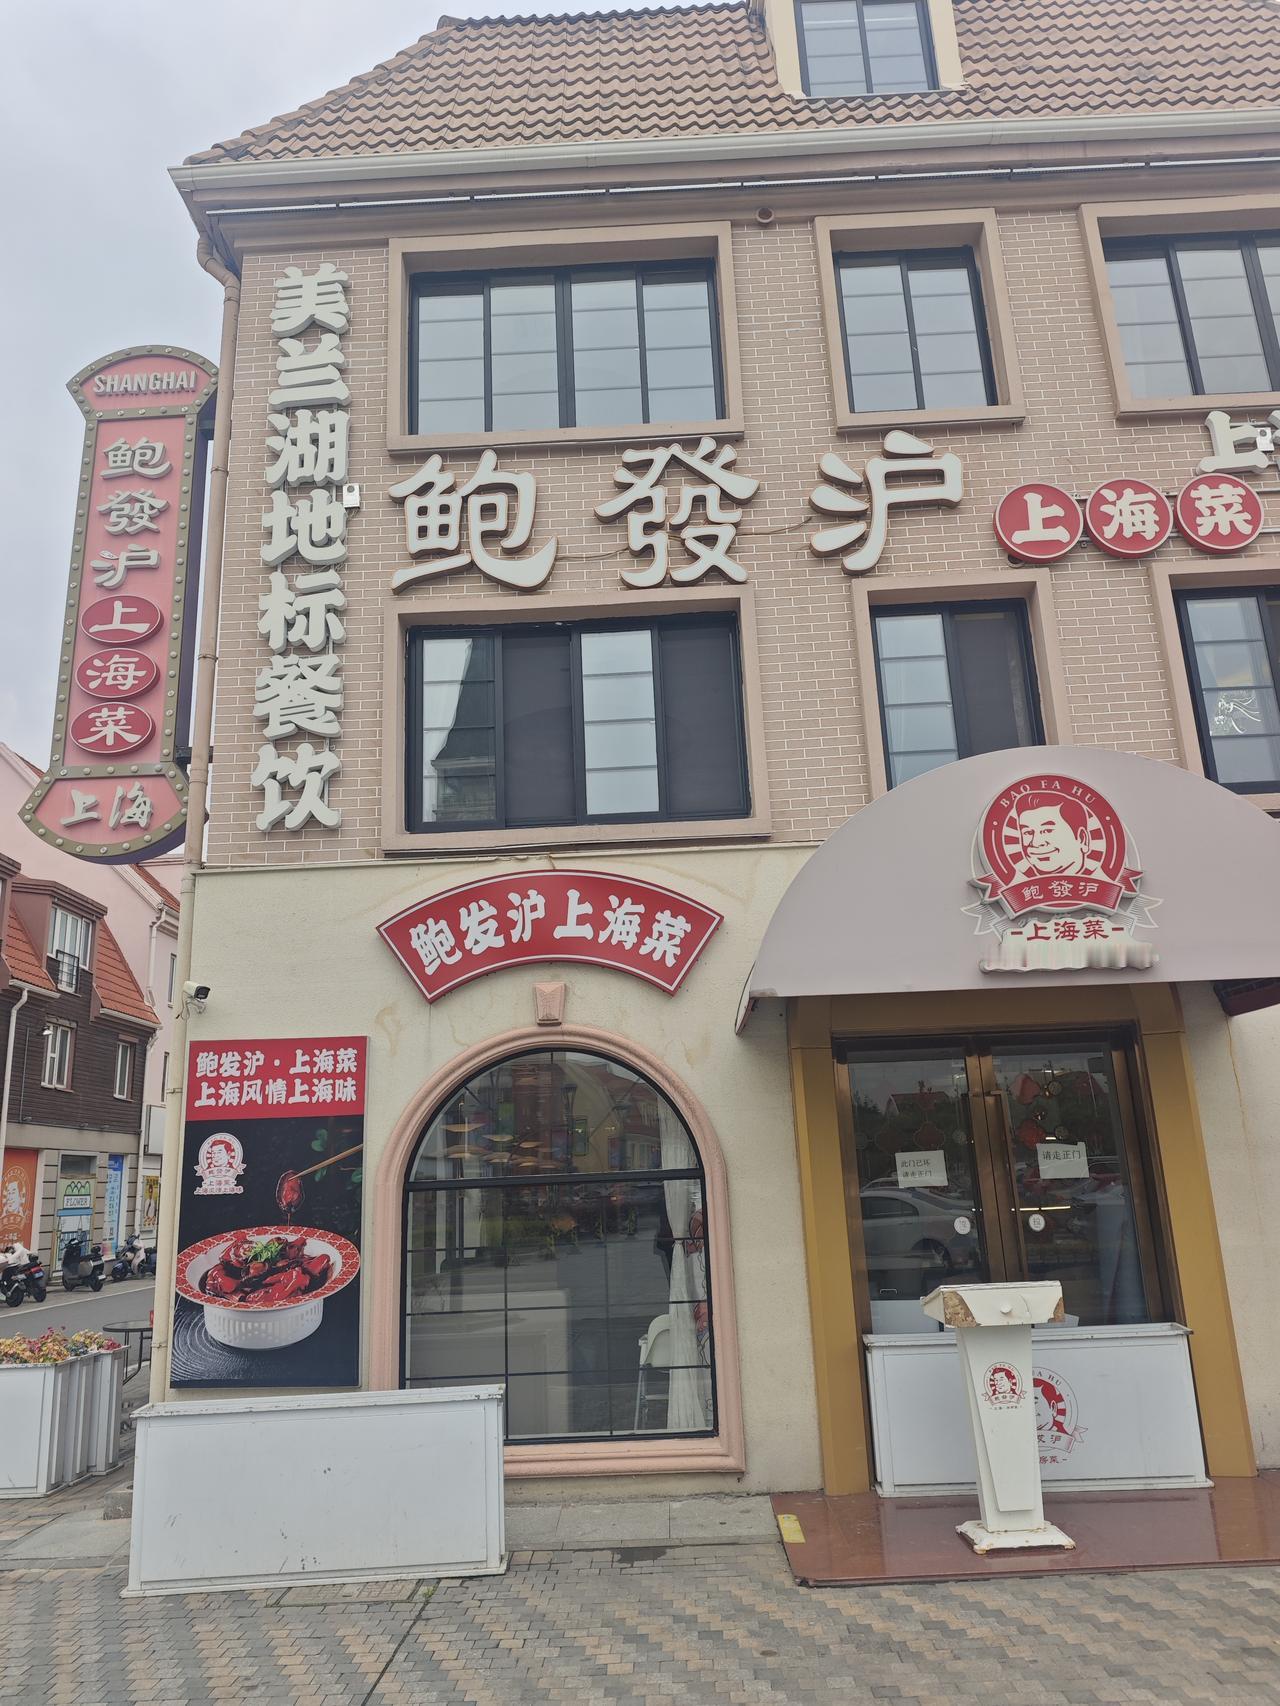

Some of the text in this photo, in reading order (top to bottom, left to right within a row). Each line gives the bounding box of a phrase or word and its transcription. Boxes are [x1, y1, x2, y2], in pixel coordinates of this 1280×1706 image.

[92, 369, 197, 396] SHANGHAI
[1196, 410, 1280, 476] 上
[388, 429, 965, 593] 鲍發沪
[1010, 483, 1254, 541] 上海菜
[251, 262, 352, 832] 美兰湖地标餐饮
[77, 600, 152, 745] 上海菜
[60, 784, 155, 831] 上海
[999, 780, 1097, 809] BAO FA HU
[409, 888, 692, 976] 鲍发沪上海菜
[193, 1077, 358, 1108] 上海风情上海味
[1042, 1149, 1081, 1161] 请走正门
